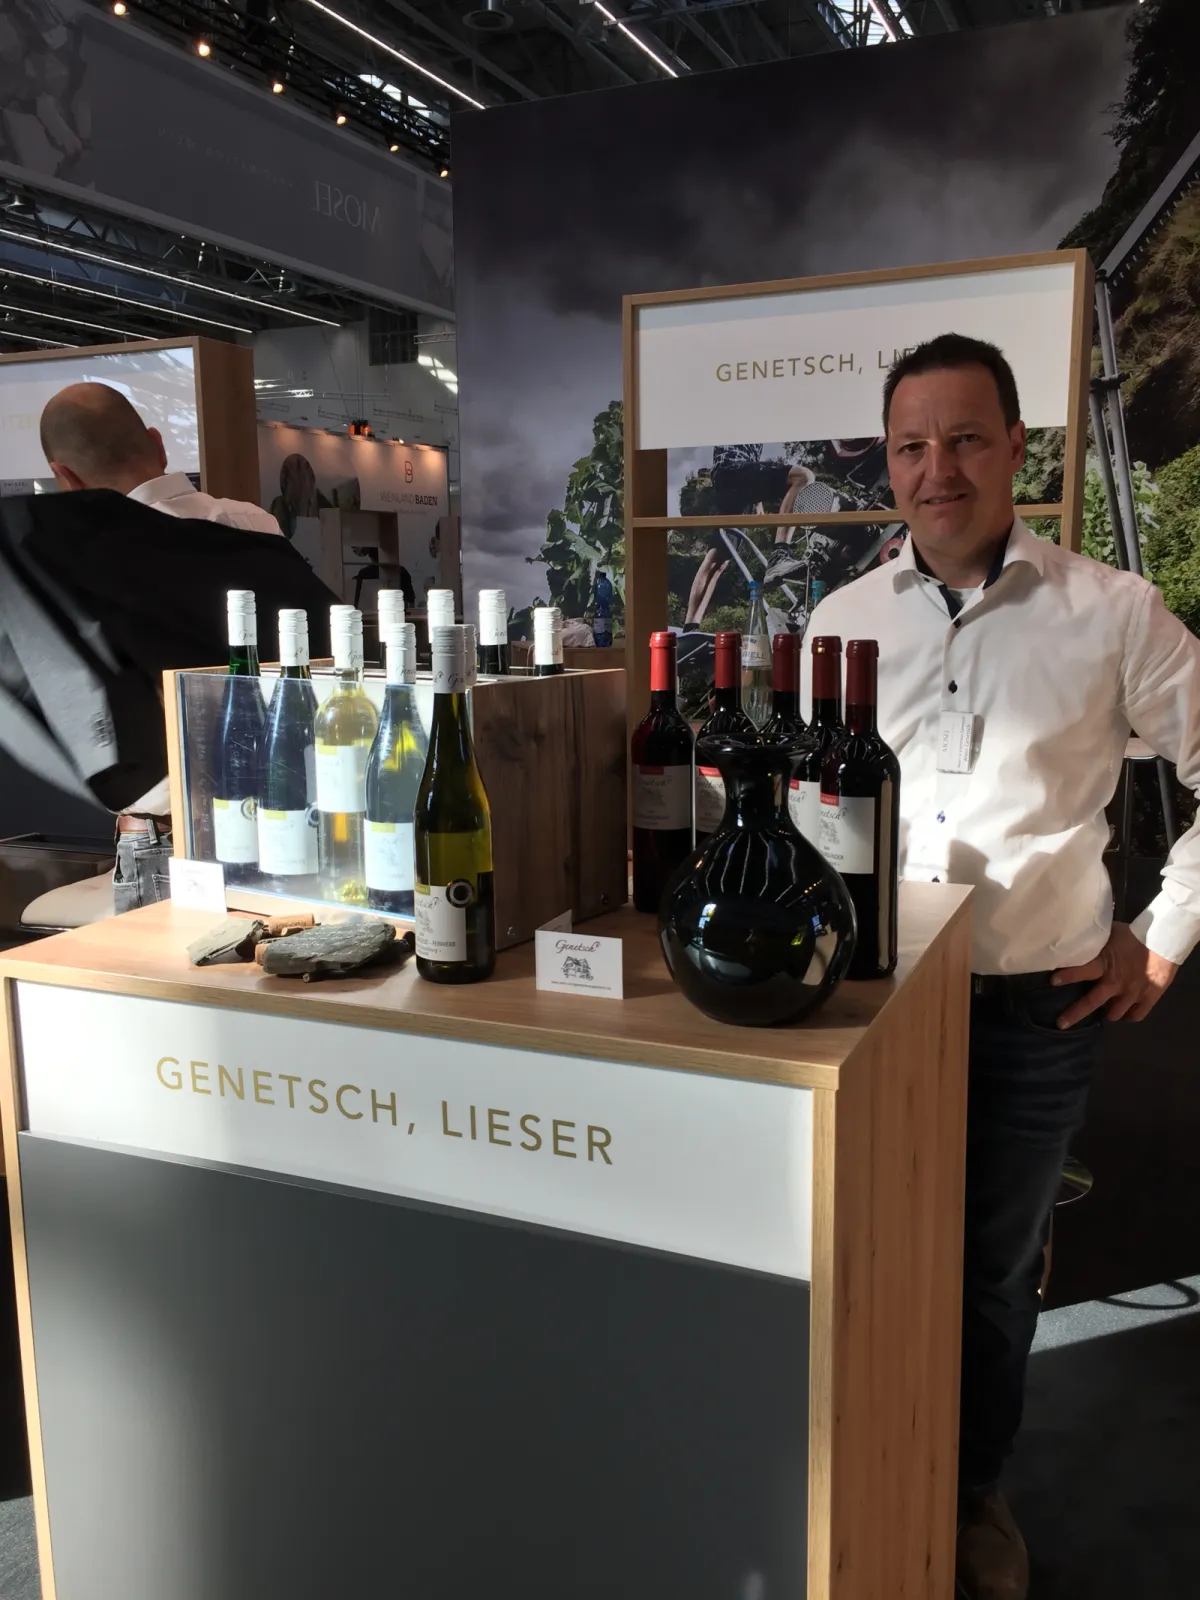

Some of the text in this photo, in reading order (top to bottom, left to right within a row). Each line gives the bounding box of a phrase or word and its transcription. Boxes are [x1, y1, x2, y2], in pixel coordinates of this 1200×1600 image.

[716, 352, 863, 382] GENETSCH,
[156, 1055, 614, 1166] GENETSCH, LIESER
